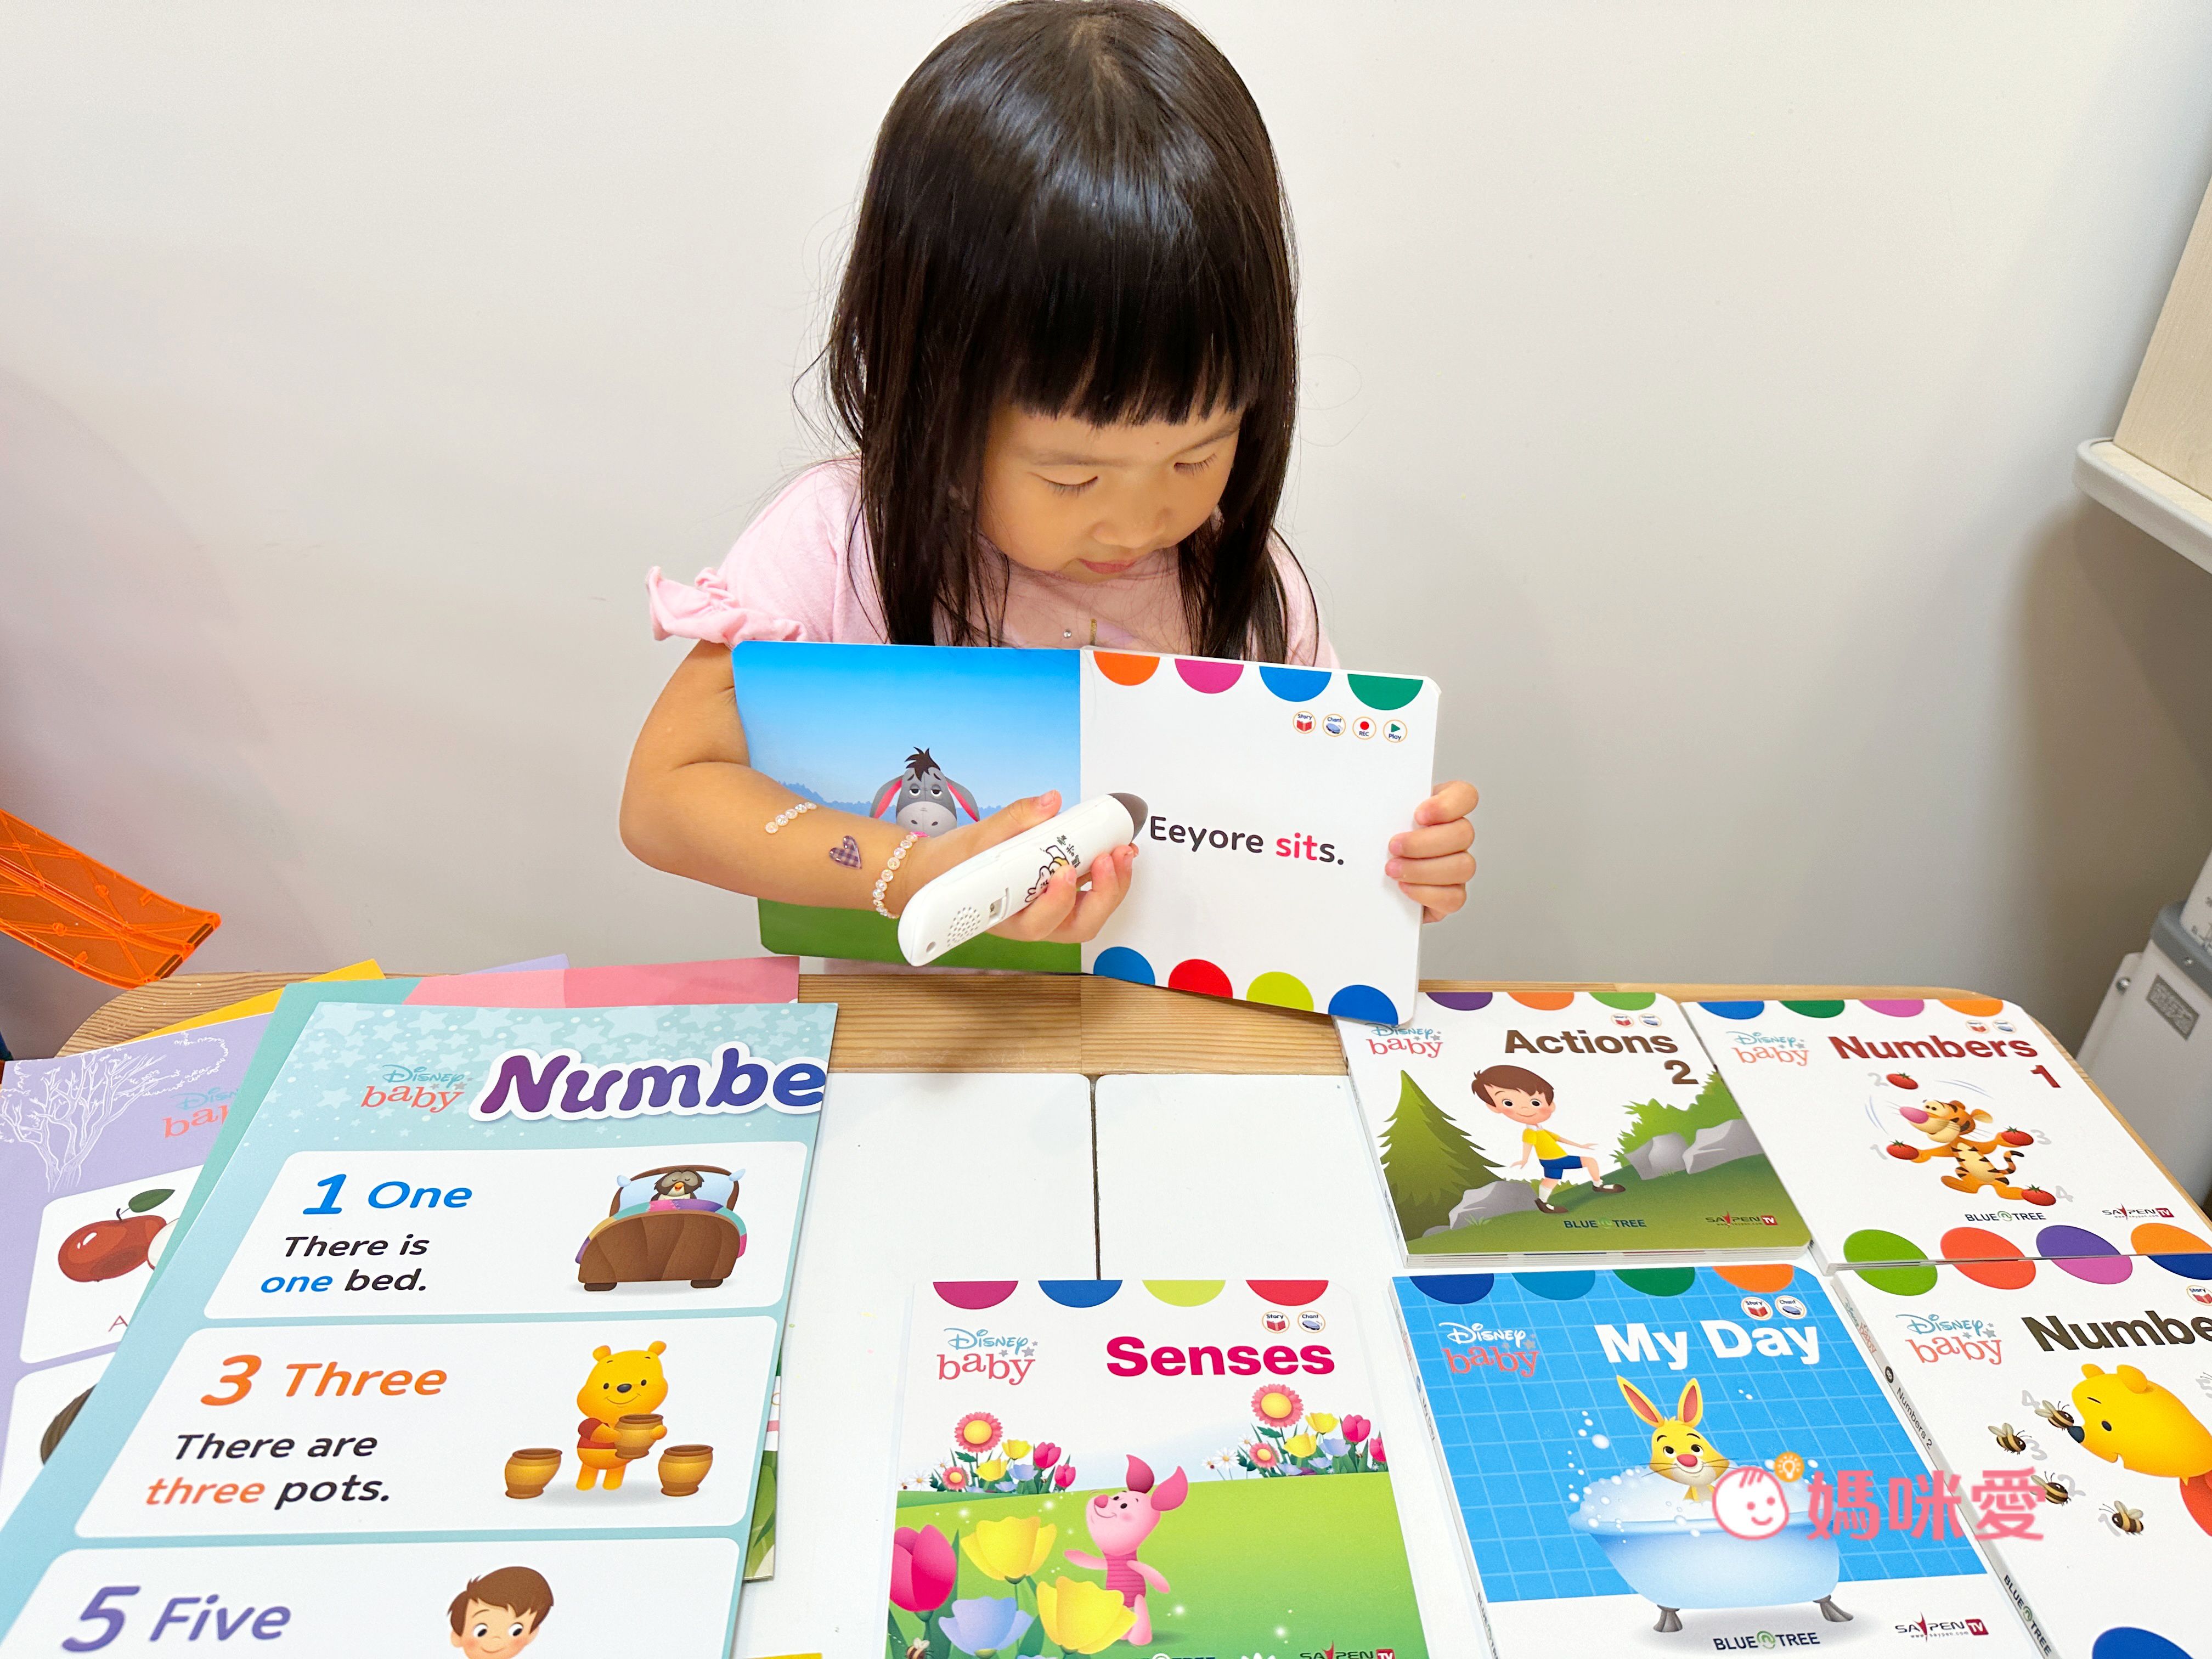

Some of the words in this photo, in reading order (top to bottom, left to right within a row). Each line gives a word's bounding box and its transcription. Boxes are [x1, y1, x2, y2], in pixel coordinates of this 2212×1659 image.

[1149, 815, 1263, 853] Eeyore
[1276, 833, 1344, 866] sits.
[1366, 1038, 1443, 1058] baby
[1504, 1030, 1678, 1054] Actions
[1828, 1035, 2038, 1059] Numbers
[1732, 1046, 1809, 1066] baby
[1664, 1059, 1699, 1085] 2
[1867, 1072, 1888, 1086] 2
[2030, 1064, 2061, 1088] 1
[360, 1085, 464, 1114] baby
[2030, 1128, 2051, 1144] 3
[302, 1173, 347, 1215] 1
[369, 1181, 472, 1209] One
[2056, 1185, 2074, 1202] 4
[285, 1235, 388, 1257] There
[399, 1234, 428, 1256] is
[261, 1274, 332, 1293] one
[345, 1267, 427, 1291] bed.
[1106, 1336, 1335, 1376] Senses
[1593, 1323, 1688, 1370] My
[1704, 1321, 1821, 1365] Day
[1906, 1337, 2002, 1365] baby
[938, 1353, 1036, 1386] baby
[1442, 1347, 1539, 1378] baby
[200, 1355, 262, 1406] 3
[285, 1361, 447, 1397] Three
[1897, 1387, 1926, 1440] Numbers
[1926, 1438, 1932, 1450] 2
[175, 1433, 294, 1460] There
[307, 1436, 378, 1457] are
[2025, 1439, 2047, 1460] 3
[146, 1476, 265, 1505] three
[274, 1474, 390, 1510] pots.
[2057, 1474, 2086, 1497] 2
[61, 1586, 142, 1652] 5
[148, 1594, 291, 1642] Five
